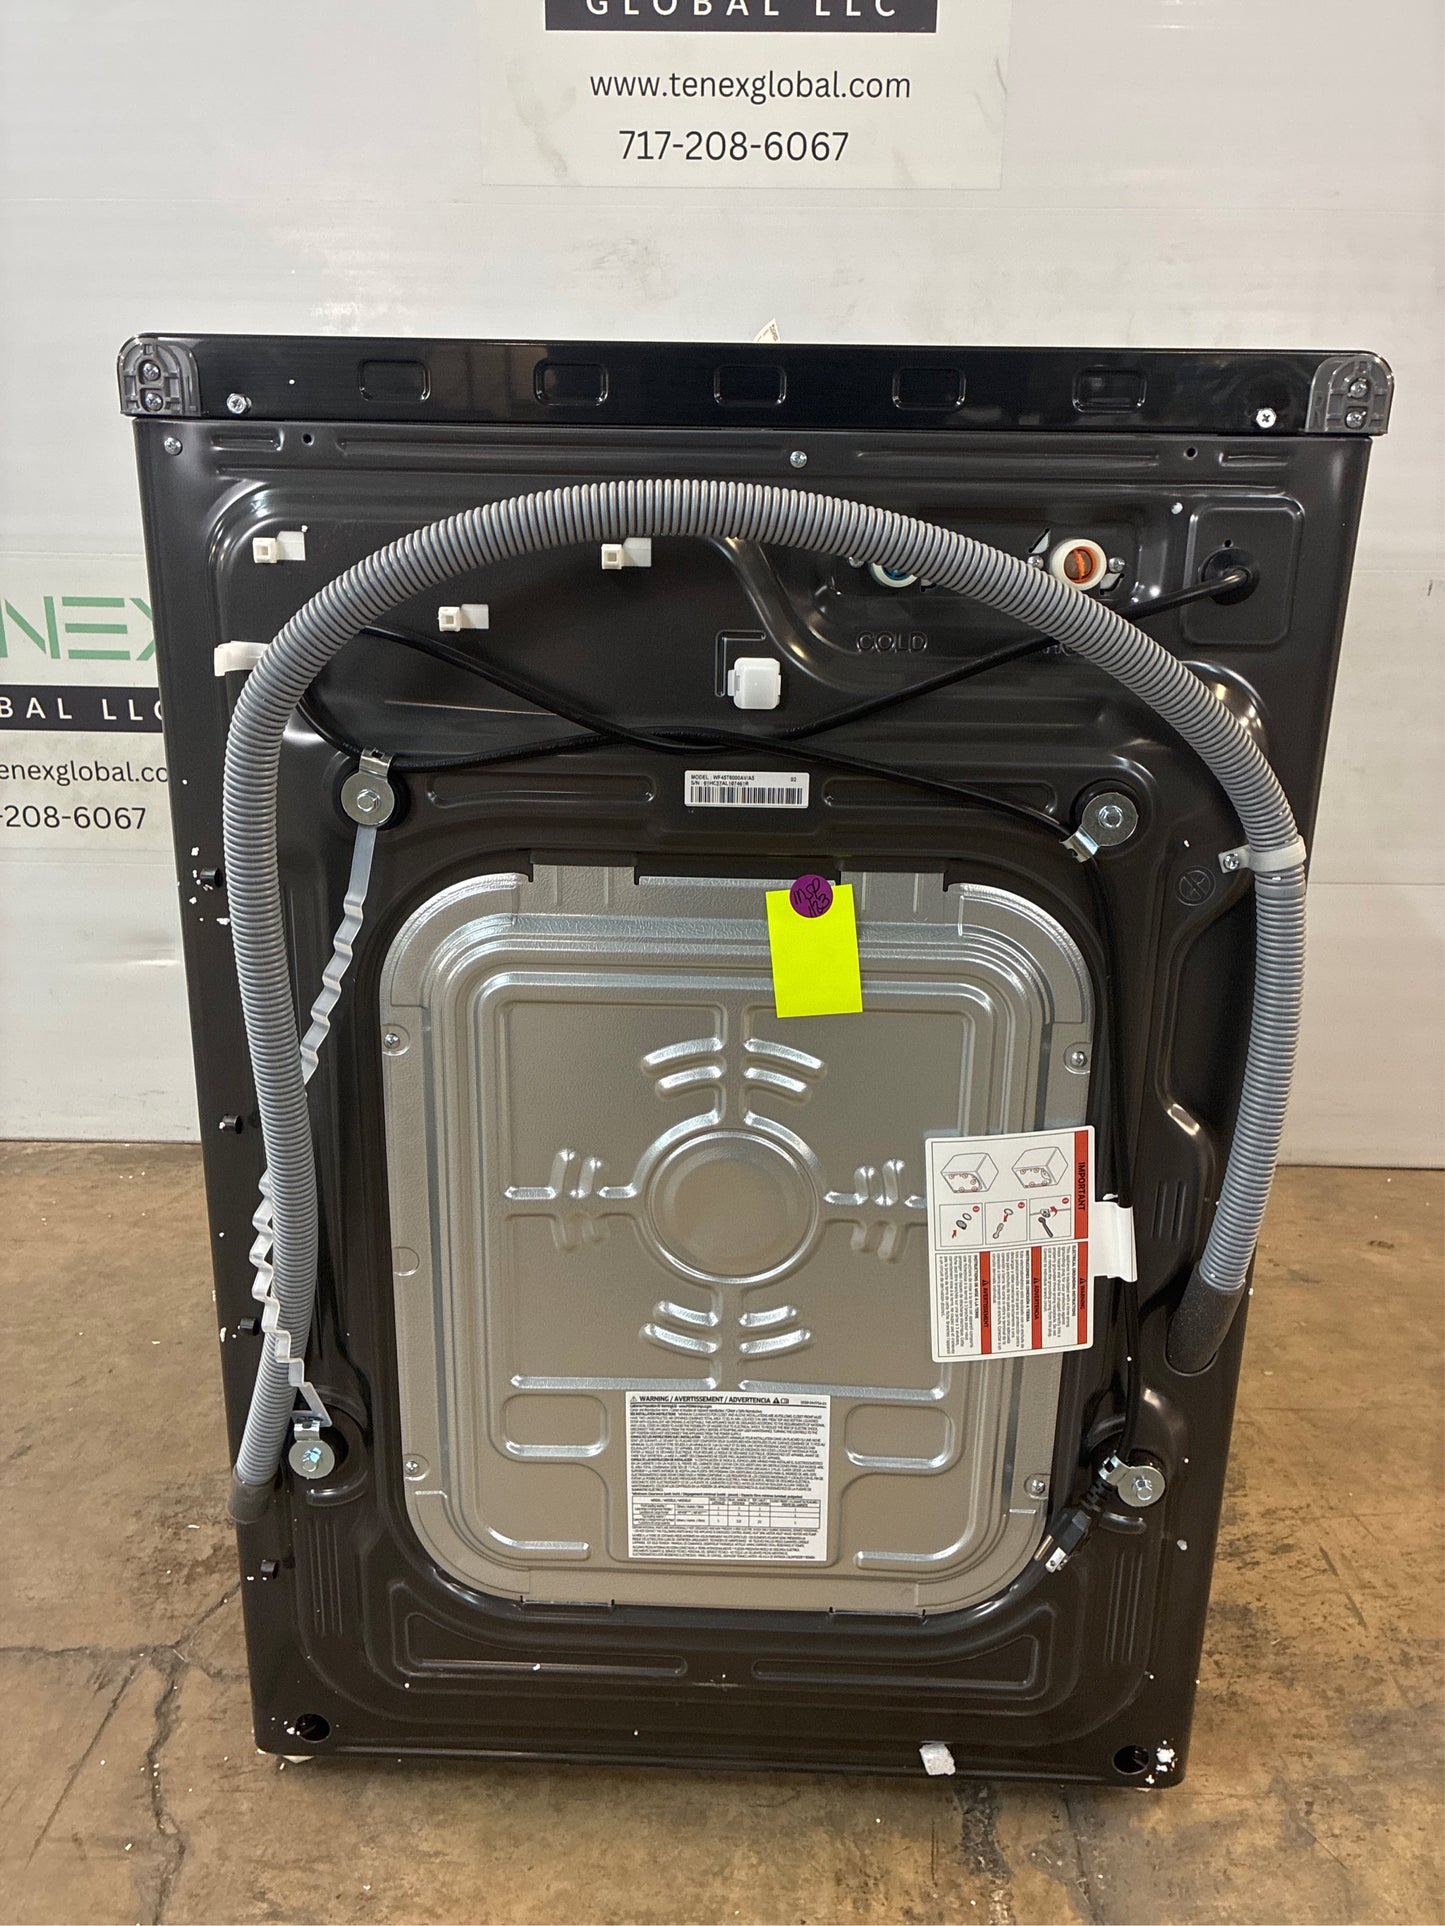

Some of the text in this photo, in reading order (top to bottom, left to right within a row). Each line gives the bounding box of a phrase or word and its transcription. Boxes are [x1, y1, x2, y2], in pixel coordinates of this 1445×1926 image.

[586, 0, 896, 17] GLOBAL LLC
[590, 71, 912, 105] www.tenexglobal.com
[618, 131, 849, 161] 717-208-6067
[856, 631, 929, 654] COLD
[1077, 1161, 1086, 1212] IMPORTANT
